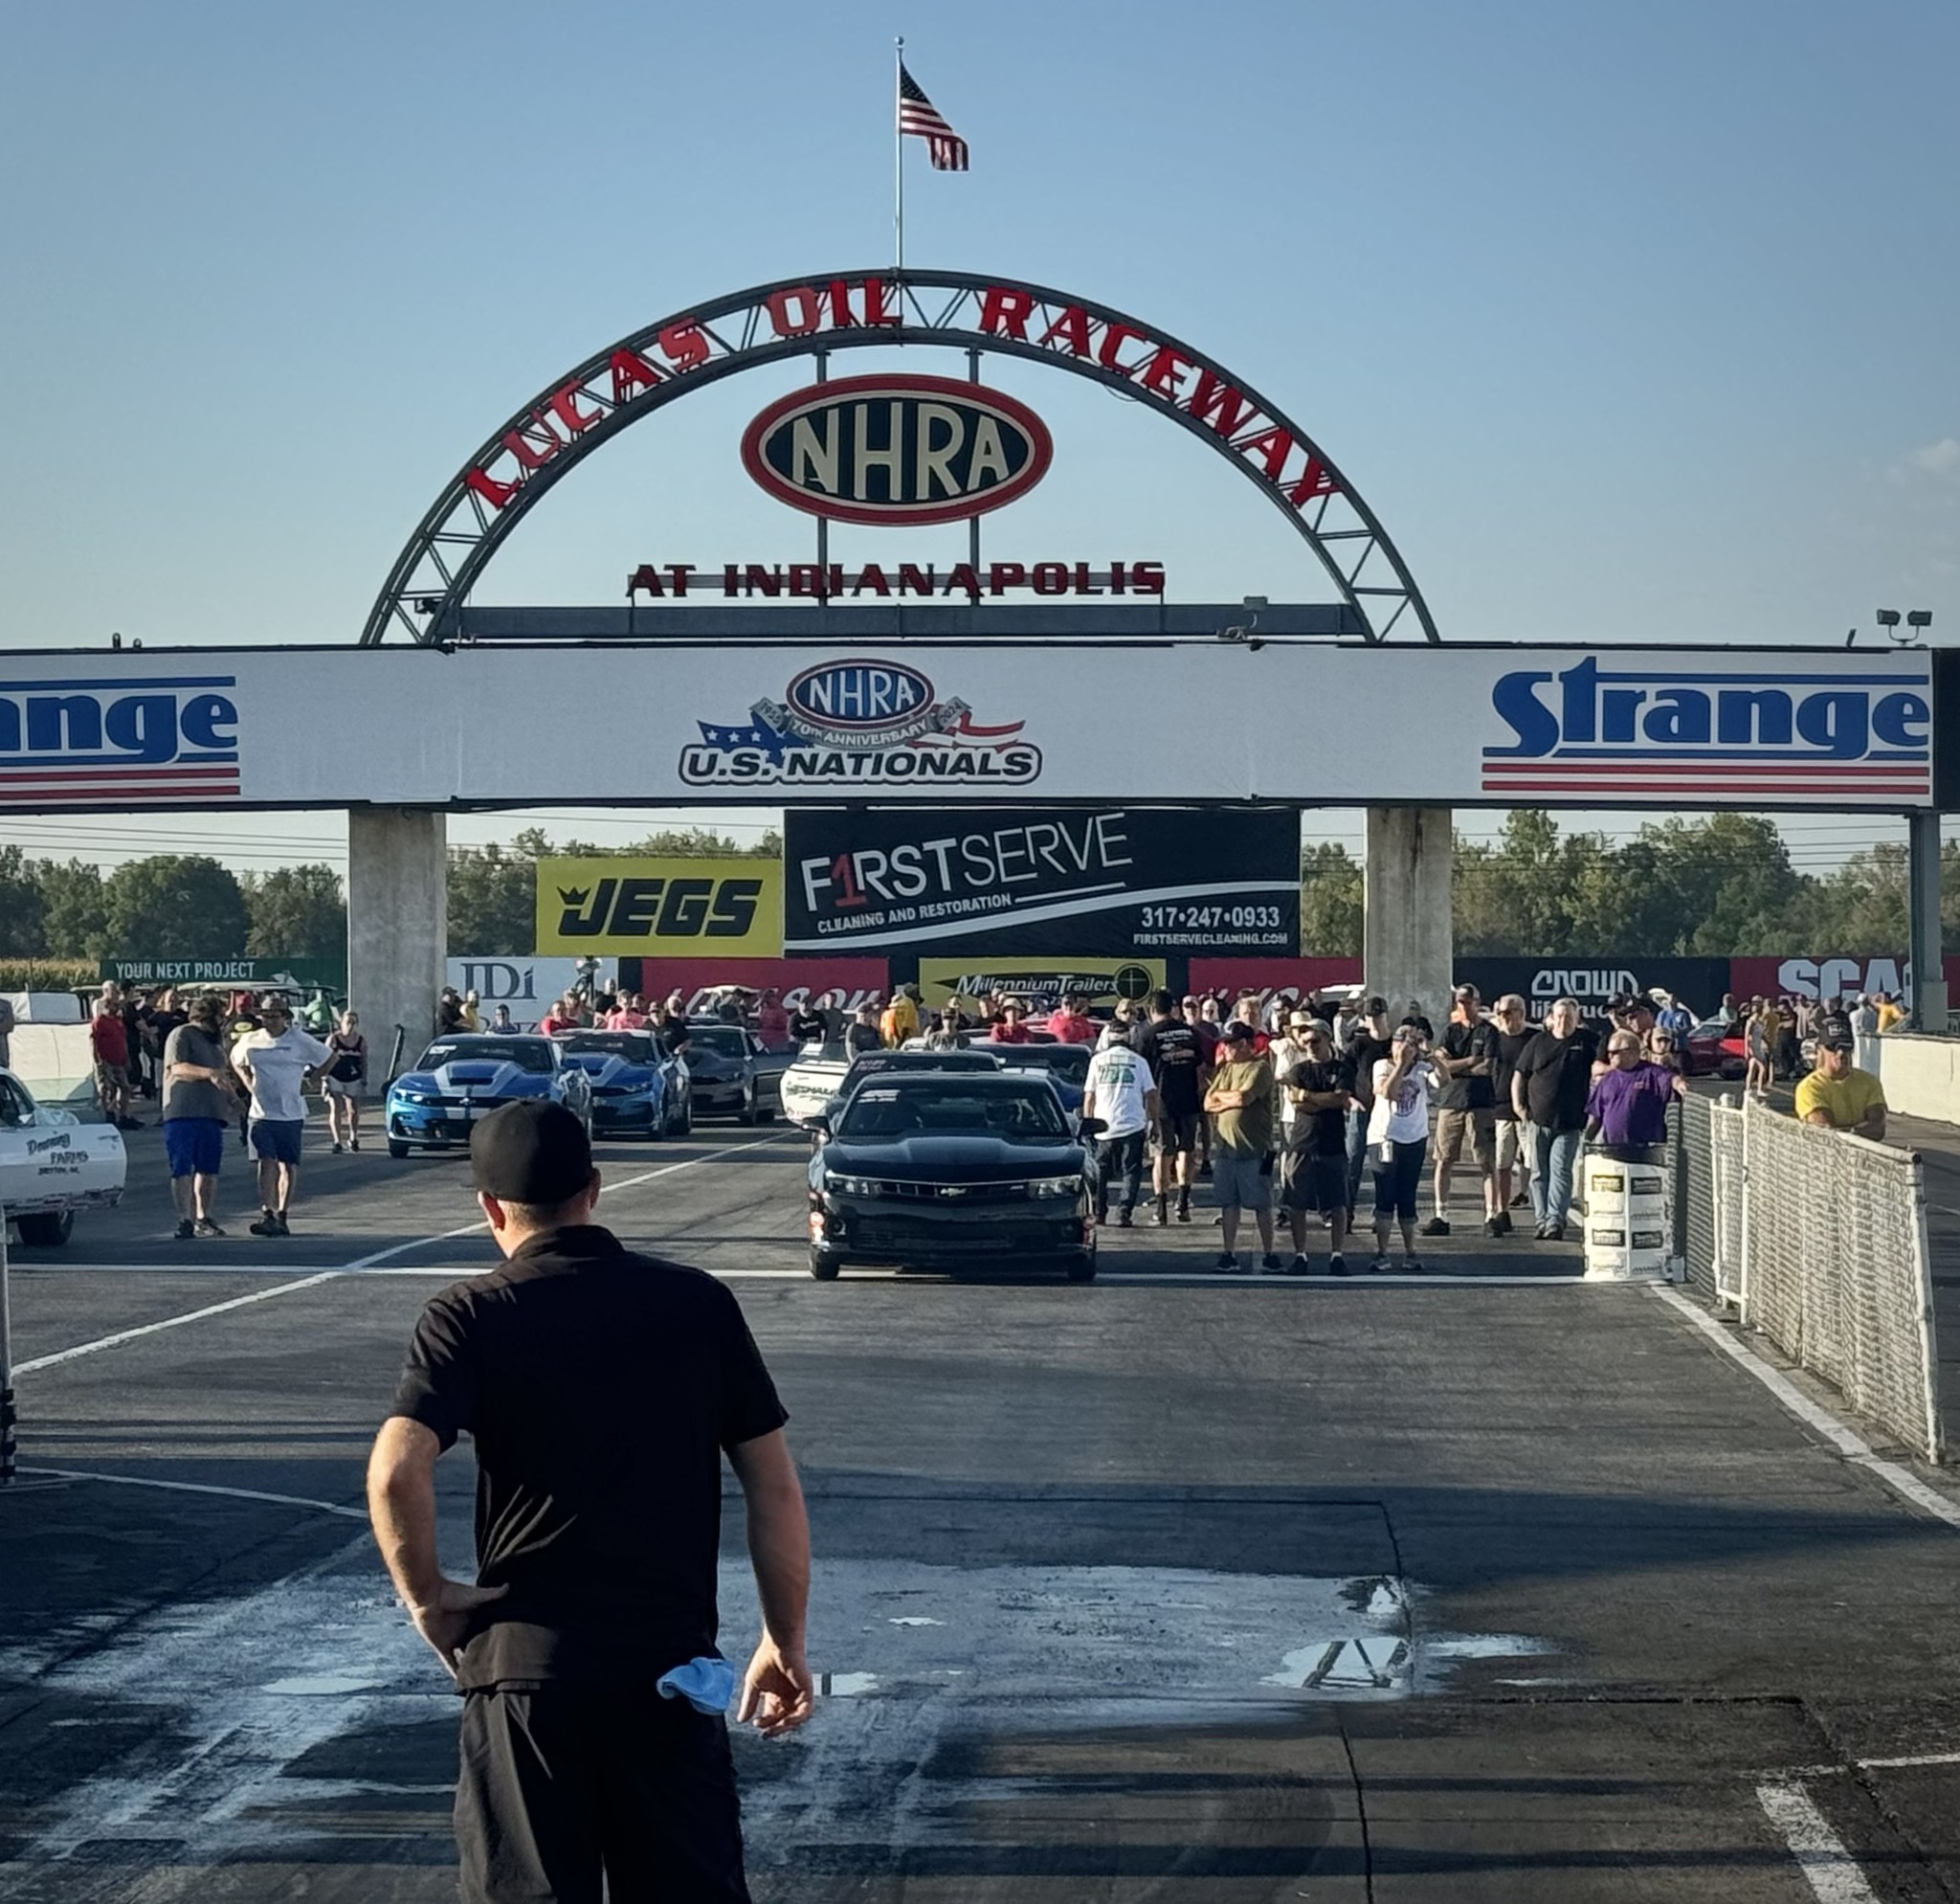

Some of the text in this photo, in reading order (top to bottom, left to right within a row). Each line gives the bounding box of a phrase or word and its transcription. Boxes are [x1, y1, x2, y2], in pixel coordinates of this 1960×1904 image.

[466, 278, 1342, 510] LUCAS OIL RACEWAY
[791, 401, 1011, 502] NHRA
[626, 561, 1167, 598] AT INDIANAPOLIS
[808, 669, 916, 718] NHRA
[1482, 656, 1930, 761] Strange
[823, 718, 927, 746] ANNIVERSARY
[687, 751, 1034, 778] U.S. NATIONALS
[558, 878, 764, 937] JEGS
[816, 893, 1013, 934] CLEANING AND RESTORATION
[116, 962, 256, 979] YOUR NEXT PROJECT
[1778, 959, 1912, 1013] SCA
